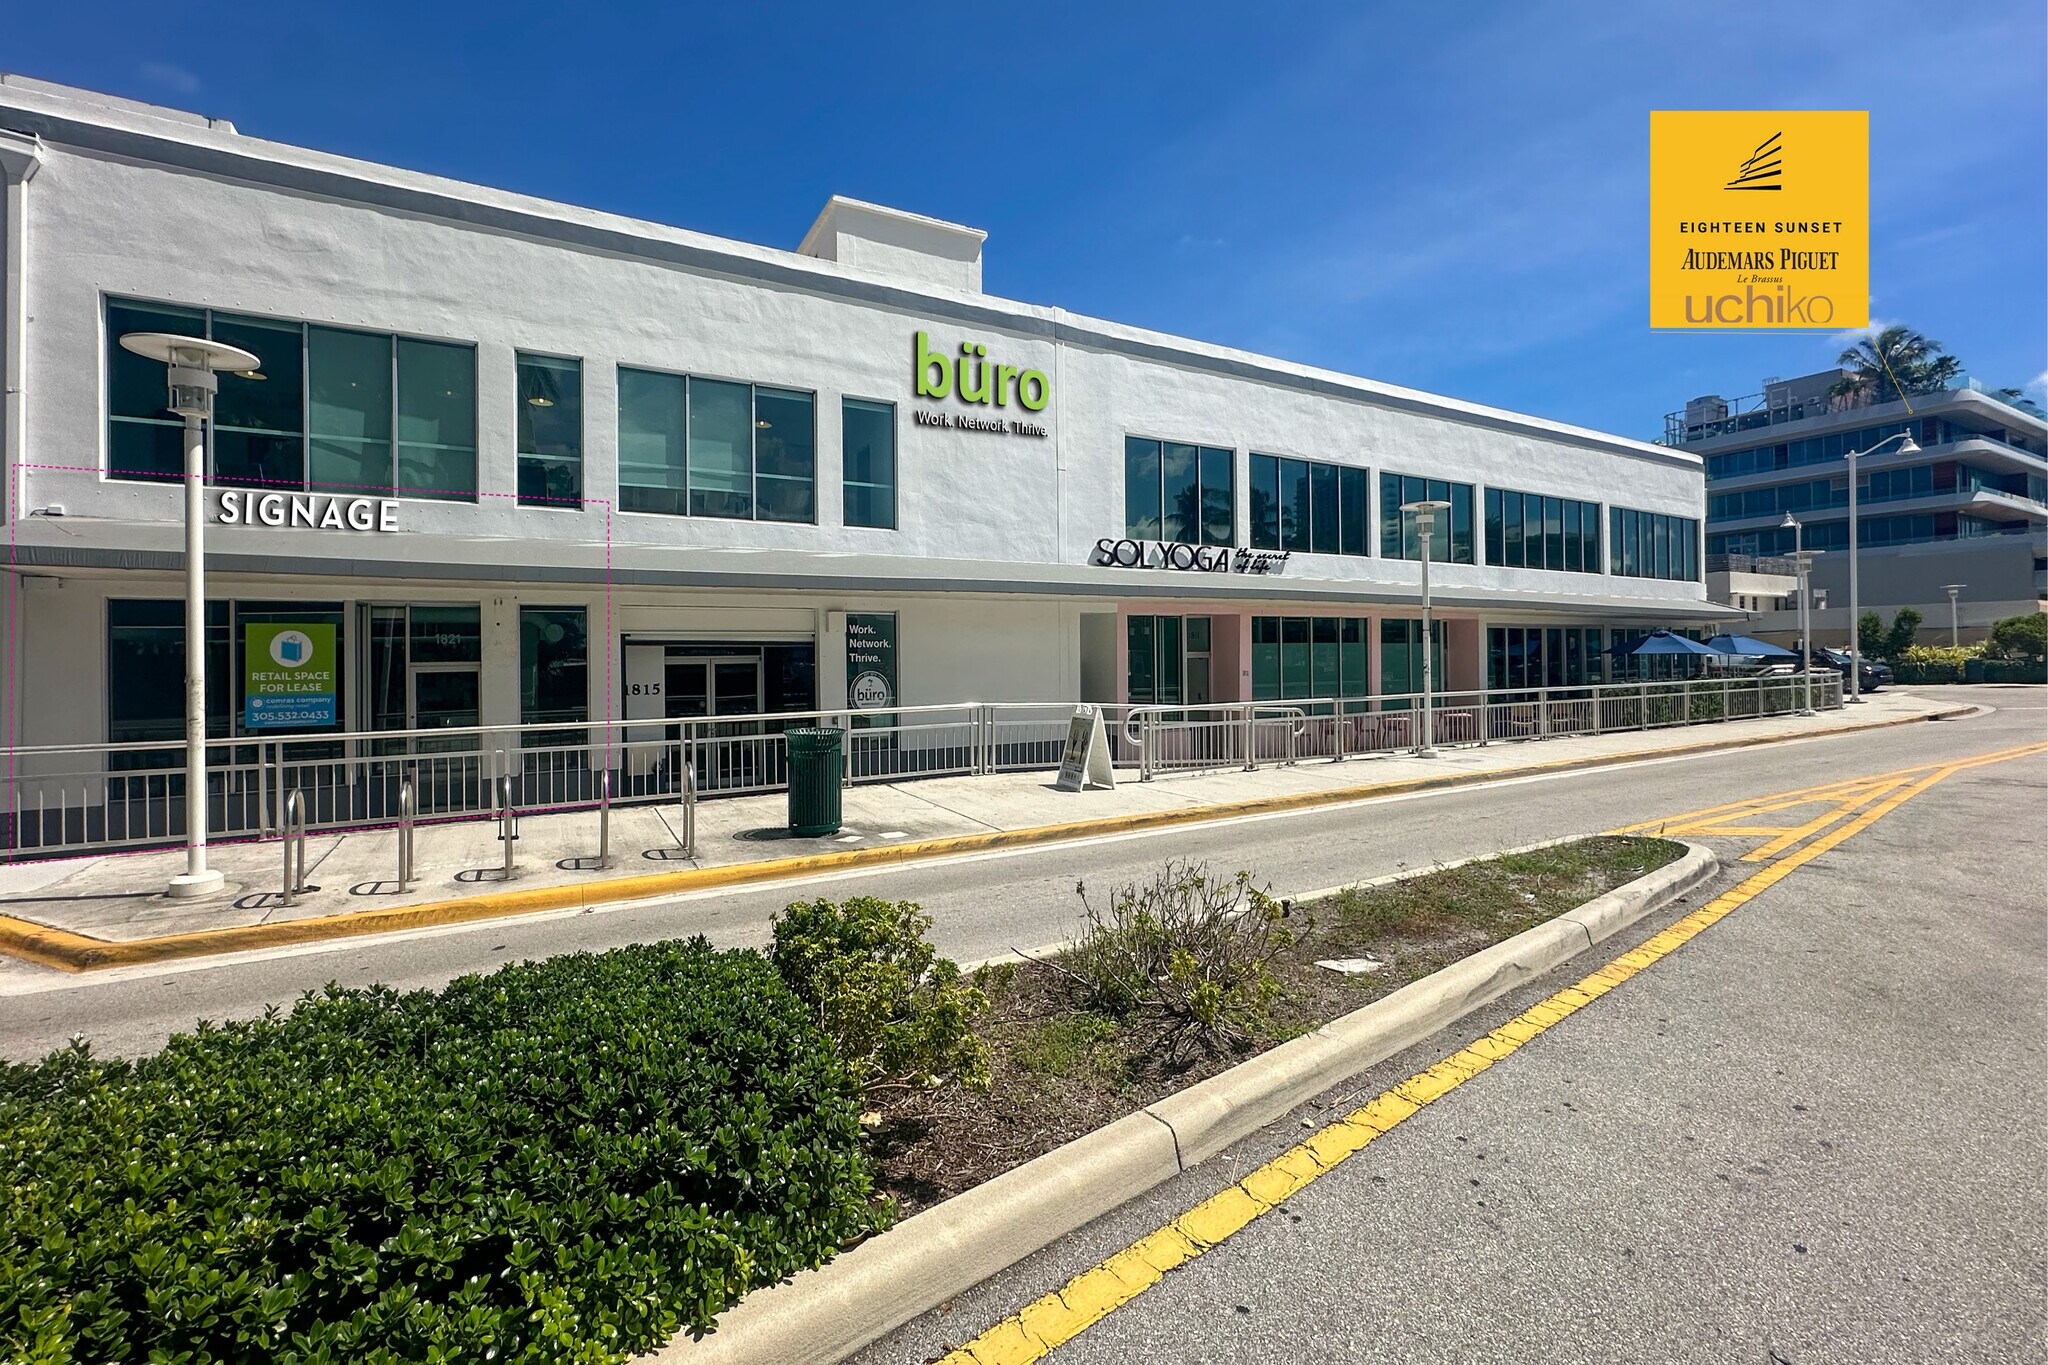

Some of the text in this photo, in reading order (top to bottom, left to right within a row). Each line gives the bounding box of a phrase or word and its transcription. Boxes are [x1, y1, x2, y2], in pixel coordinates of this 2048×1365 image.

[916, 331, 1050, 411] büro
[916, 410, 1048, 437] Work. Network. Thrive.
[1096, 538, 1229, 572] SOL YOGA
[1235, 547, 1291, 560] the secret
[1235, 559, 1271, 574] of life
[849, 624, 876, 634] Work.
[434, 633, 461, 644] 1821
[849, 639, 892, 648] Network.
[849, 653, 881, 662] Thrive.
[252, 671, 330, 681] RETAIL SPACE
[260, 683, 322, 692] FOR LEASE
[625, 683, 660, 696] 1815
[857, 688, 885, 701] büro
[252, 711, 329, 721] 305.532.0433
